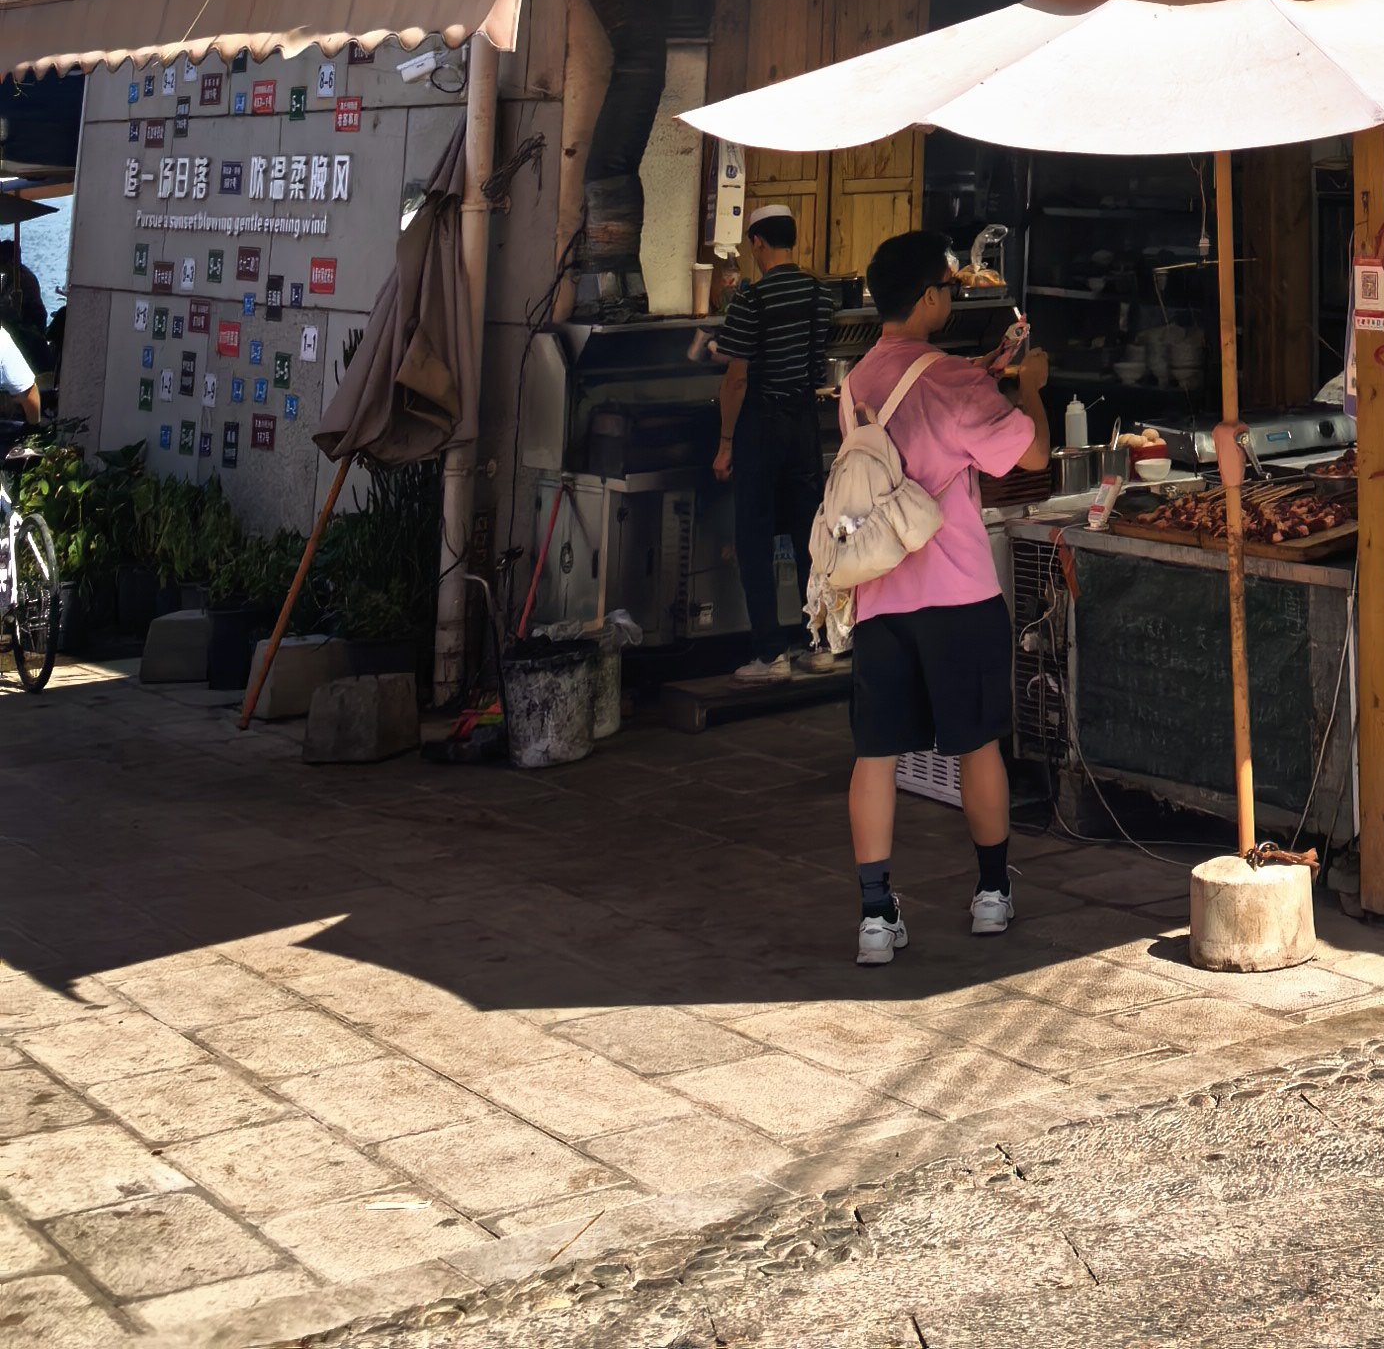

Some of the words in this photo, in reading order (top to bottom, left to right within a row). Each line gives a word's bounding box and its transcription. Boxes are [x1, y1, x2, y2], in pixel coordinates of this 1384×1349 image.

[124, 156, 210, 199] 追一场日落
[249, 154, 351, 200] 吹温柔晚风
[135, 210, 162, 229] Pursue
[169, 213, 197, 231] sunset
[198, 211, 232, 236] blowing
[233, 212, 263, 236] gentle
[264, 213, 301, 238] evening
[302, 213, 328, 235] wind
